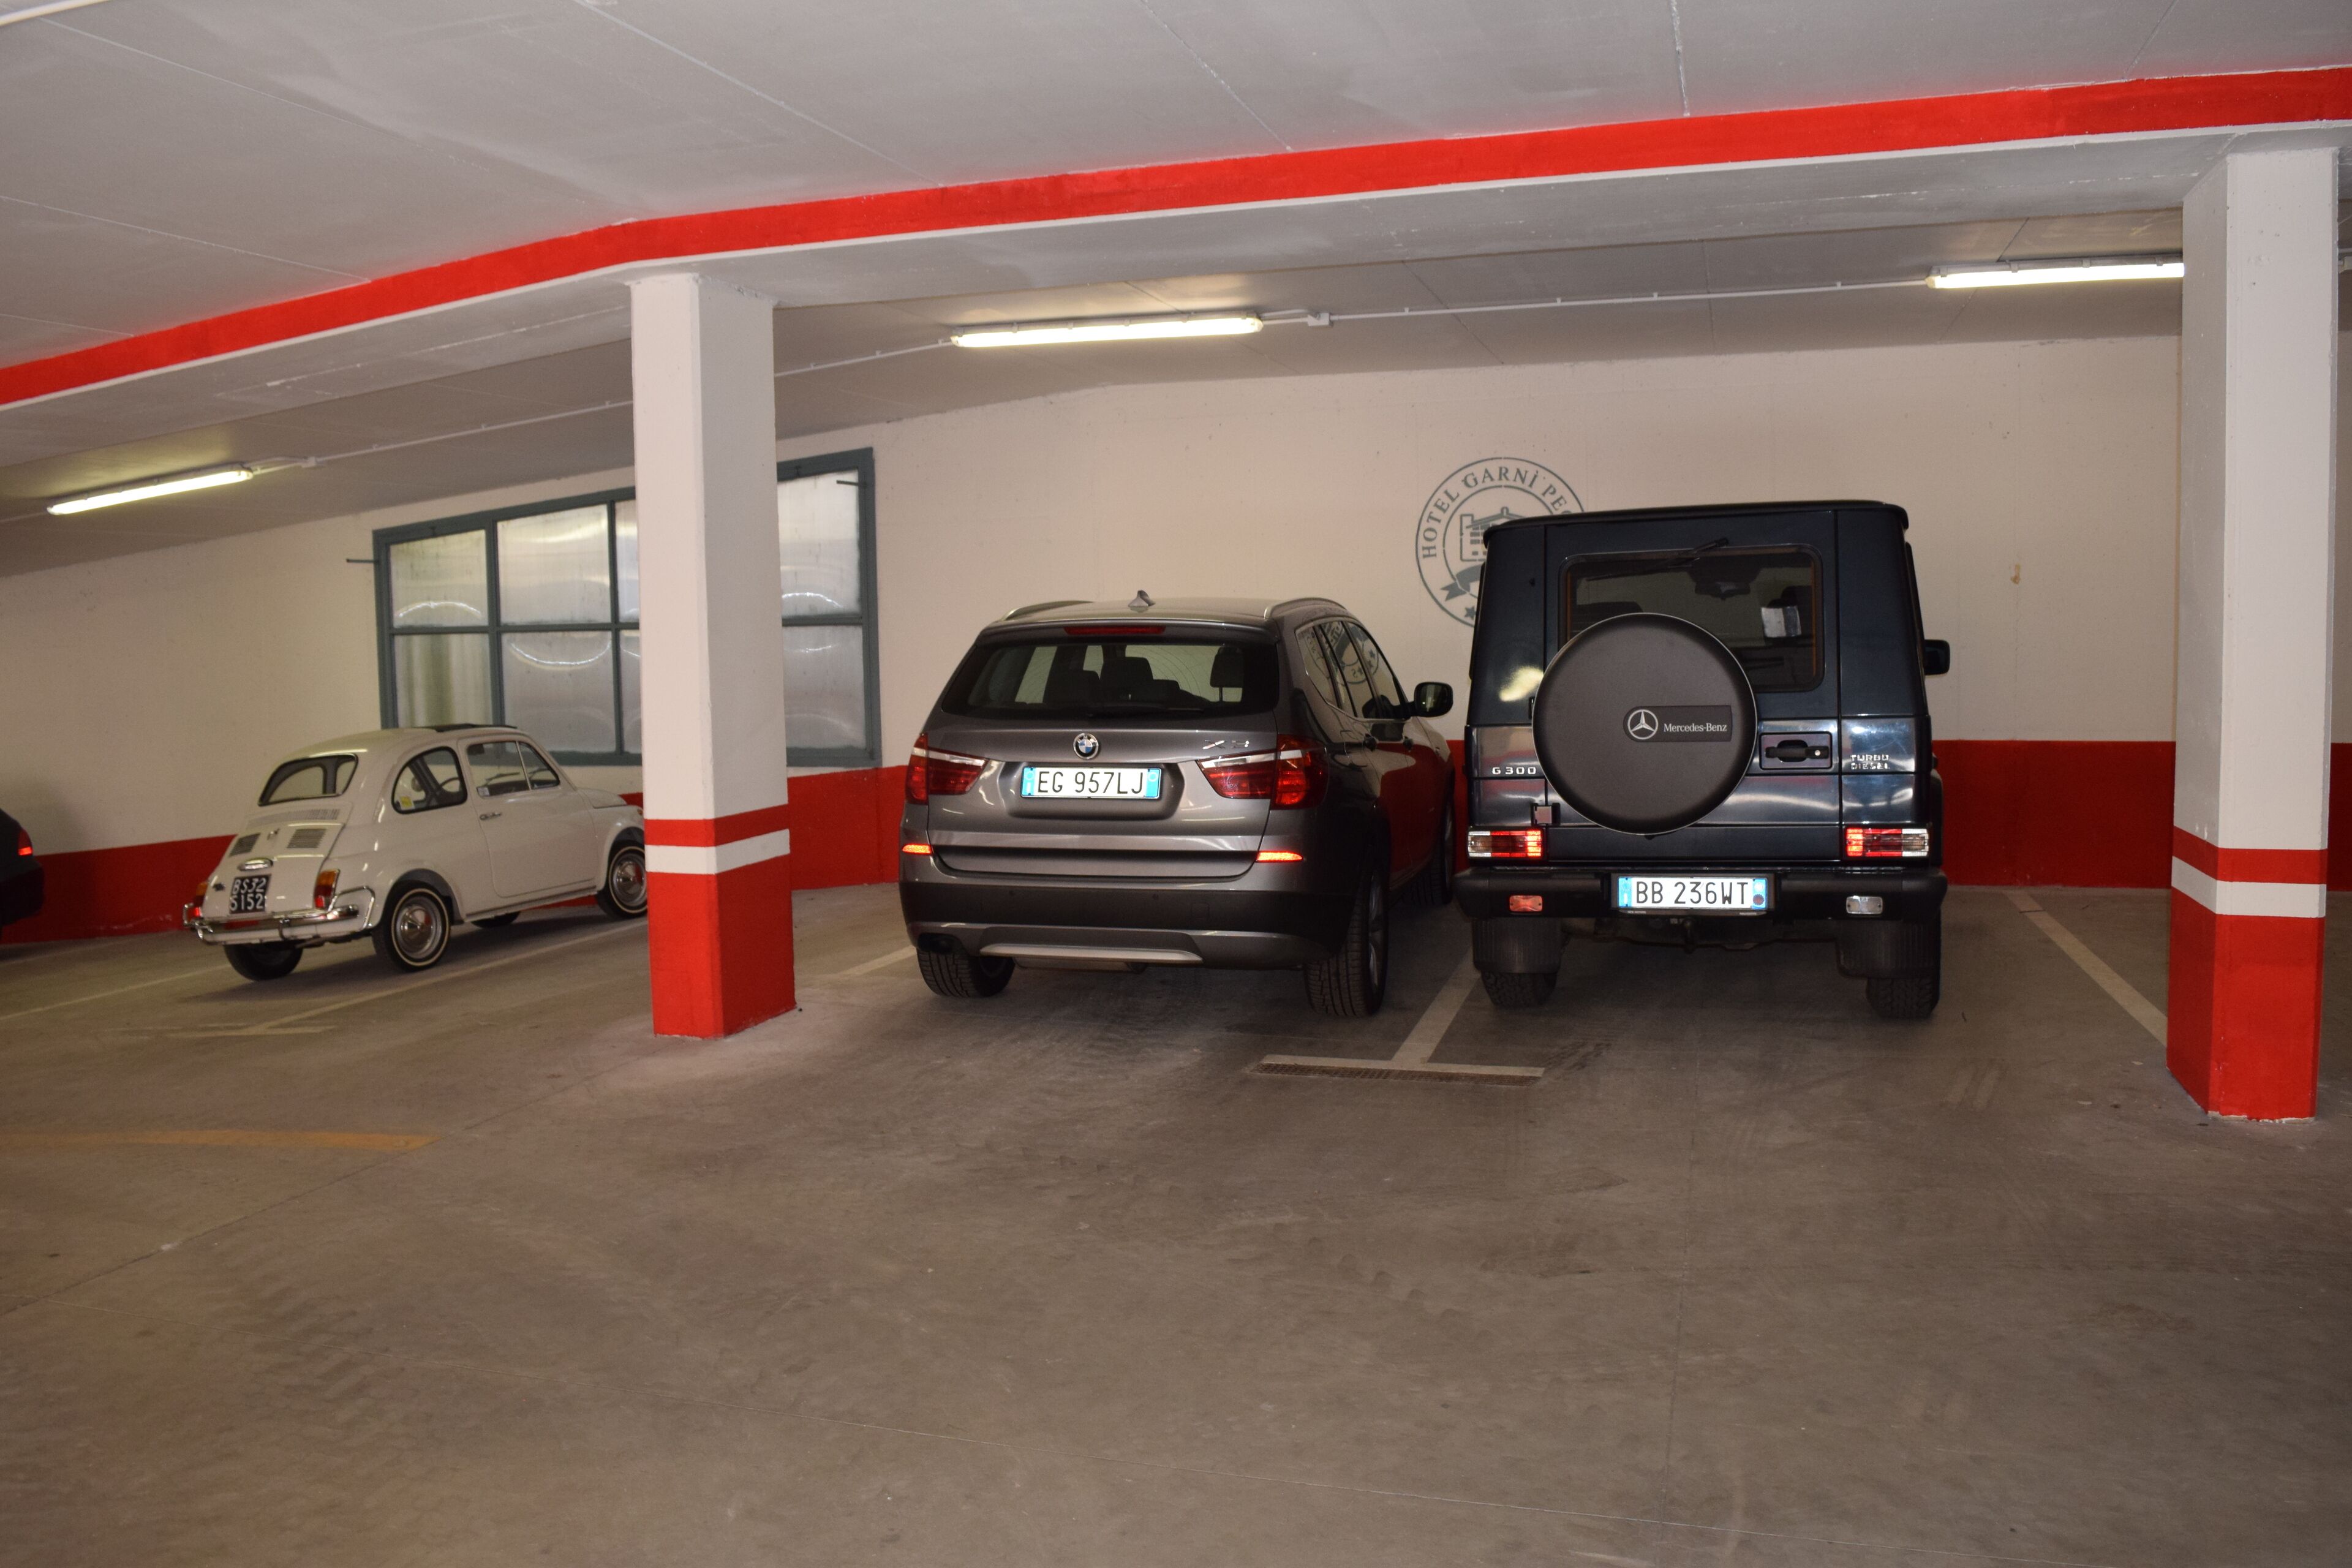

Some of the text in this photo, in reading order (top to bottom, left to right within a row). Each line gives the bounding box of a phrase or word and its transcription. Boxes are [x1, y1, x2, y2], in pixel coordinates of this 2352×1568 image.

[1422, 488, 1460, 559] HOTEL
[1542, 484, 1572, 514] PE
[1663, 722, 1727, 733] Mercedes-Benz
[1491, 766, 1536, 775] G 300
[1038, 771, 1064, 793] EG
[1074, 771, 1144, 794] 957LJ
[232, 877, 266, 894] BS32
[1636, 881, 1664, 904] BB
[1673, 881, 1749, 905] 236WT
[229, 893, 263, 911] 5152
